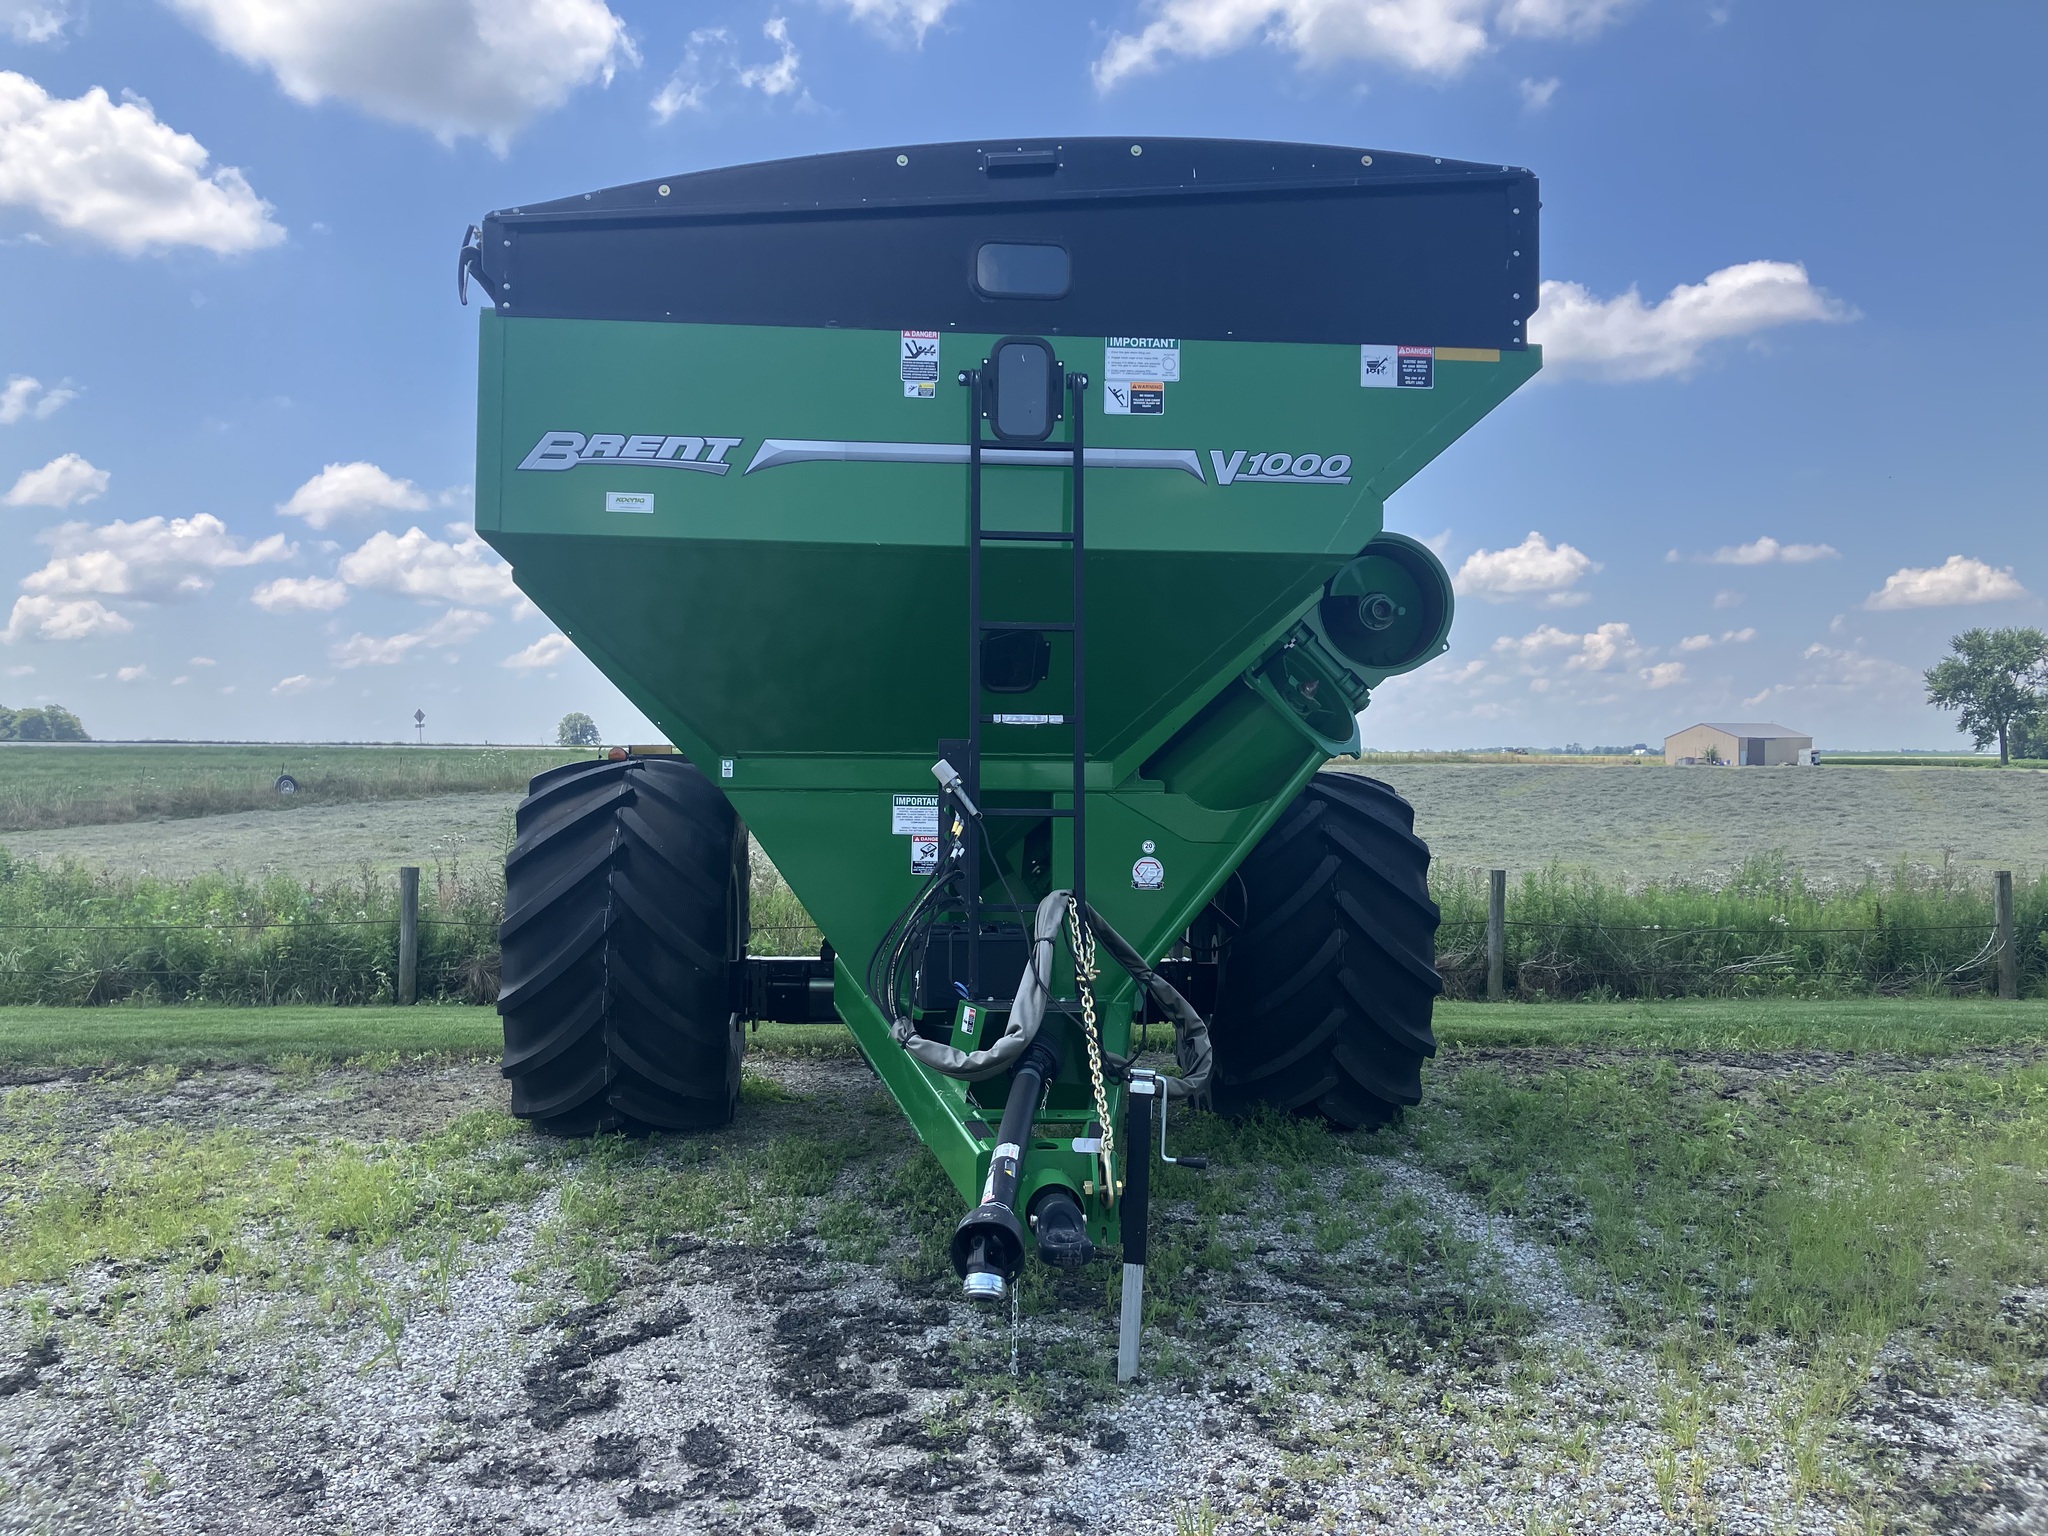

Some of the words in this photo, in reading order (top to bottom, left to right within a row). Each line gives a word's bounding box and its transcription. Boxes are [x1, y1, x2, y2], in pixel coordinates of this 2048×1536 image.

[1110, 337, 1176, 348] IMPORTANT
[1405, 347, 1432, 355] DANGER
[515, 430, 744, 473] BRENT
[1209, 449, 1353, 486] V1000
[895, 797, 939, 806] IMPORTAN
